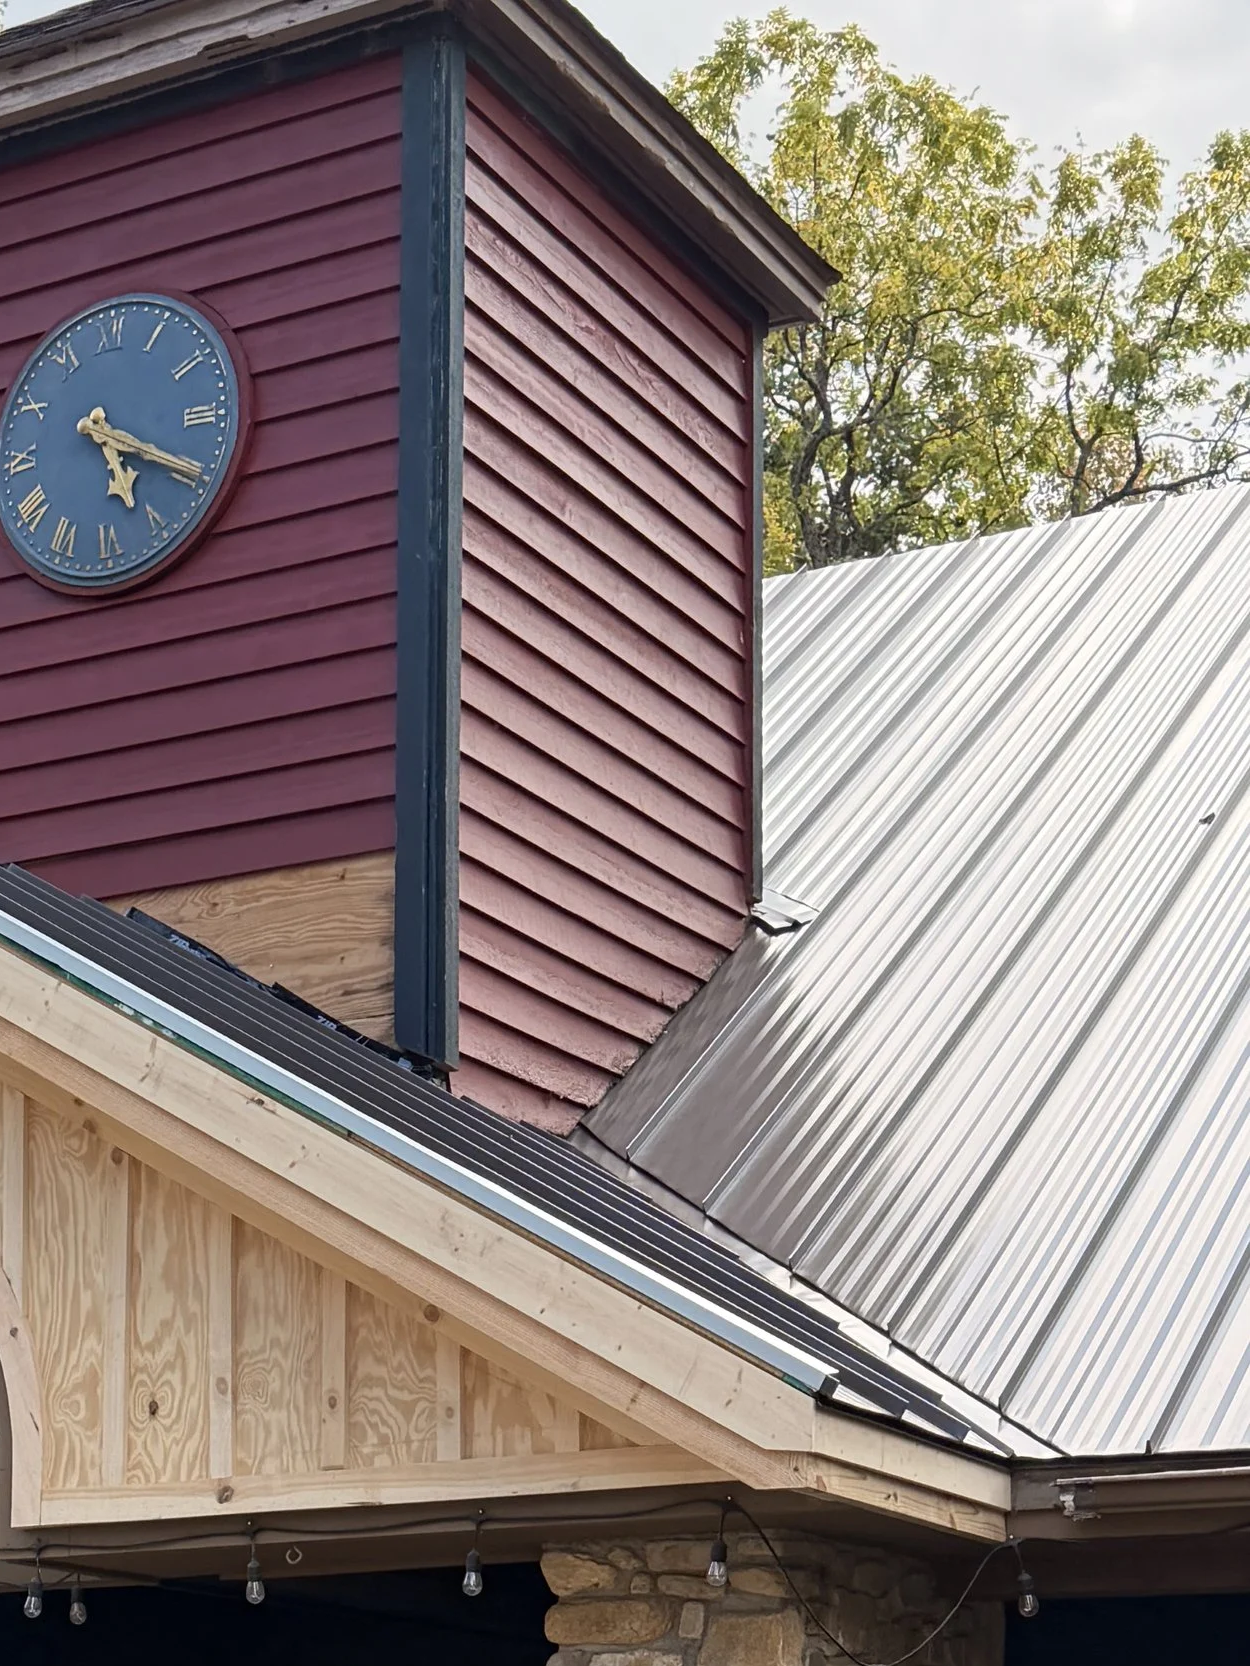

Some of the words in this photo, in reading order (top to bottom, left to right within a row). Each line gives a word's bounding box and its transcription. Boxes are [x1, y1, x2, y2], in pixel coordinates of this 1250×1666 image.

[95, 317, 124, 356] XII
[142, 321, 167, 353] I
[51, 342, 81, 383] XI
[170, 349, 204, 381] II
[21, 393, 49, 420] X
[183, 403, 216, 429] III
[10, 443, 37, 475] IX
[17, 483, 51, 534] VIII
[145, 502, 168, 536] V
[49, 517, 78, 558] VII
[97, 523, 125, 560] VI
